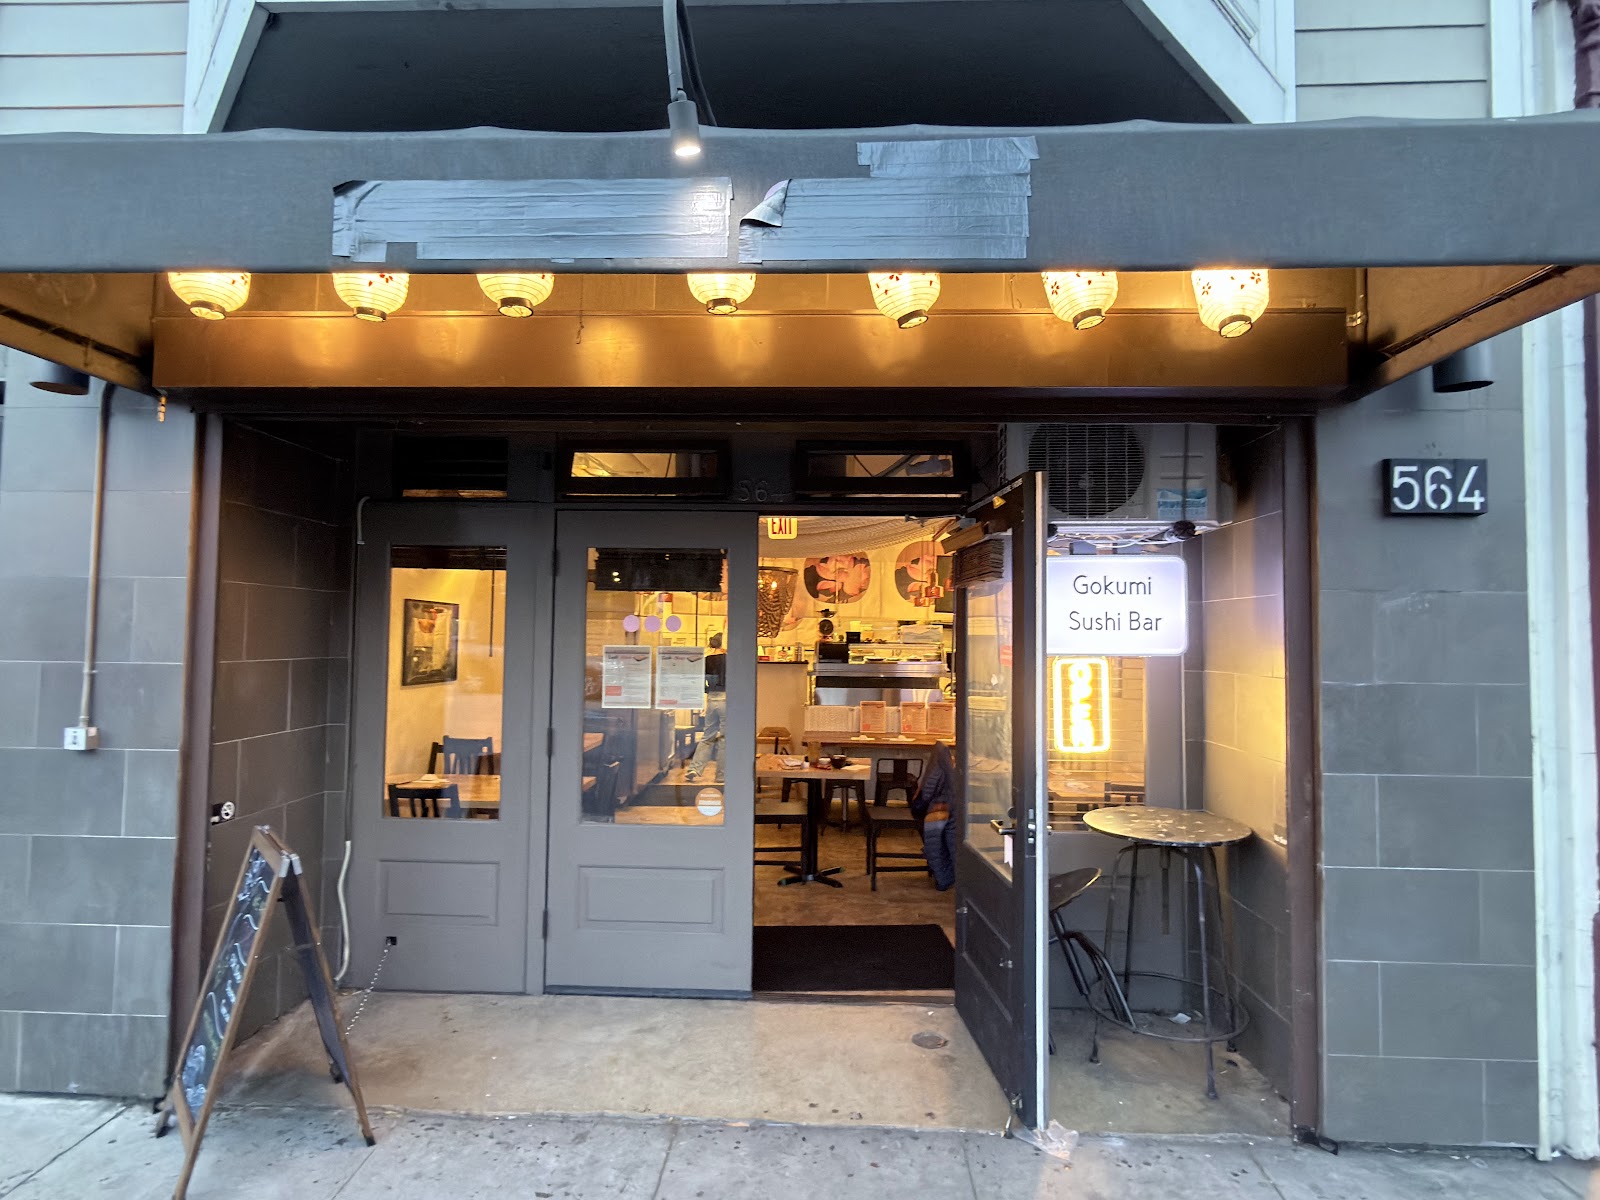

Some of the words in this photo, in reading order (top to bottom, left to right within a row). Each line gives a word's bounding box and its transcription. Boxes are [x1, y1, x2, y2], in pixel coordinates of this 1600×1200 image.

[1392, 465, 1486, 511] 564
[1073, 575, 1152, 595] Gokumi
[1069, 611, 1121, 631] Sushi
[1129, 611, 1163, 631] Bar
